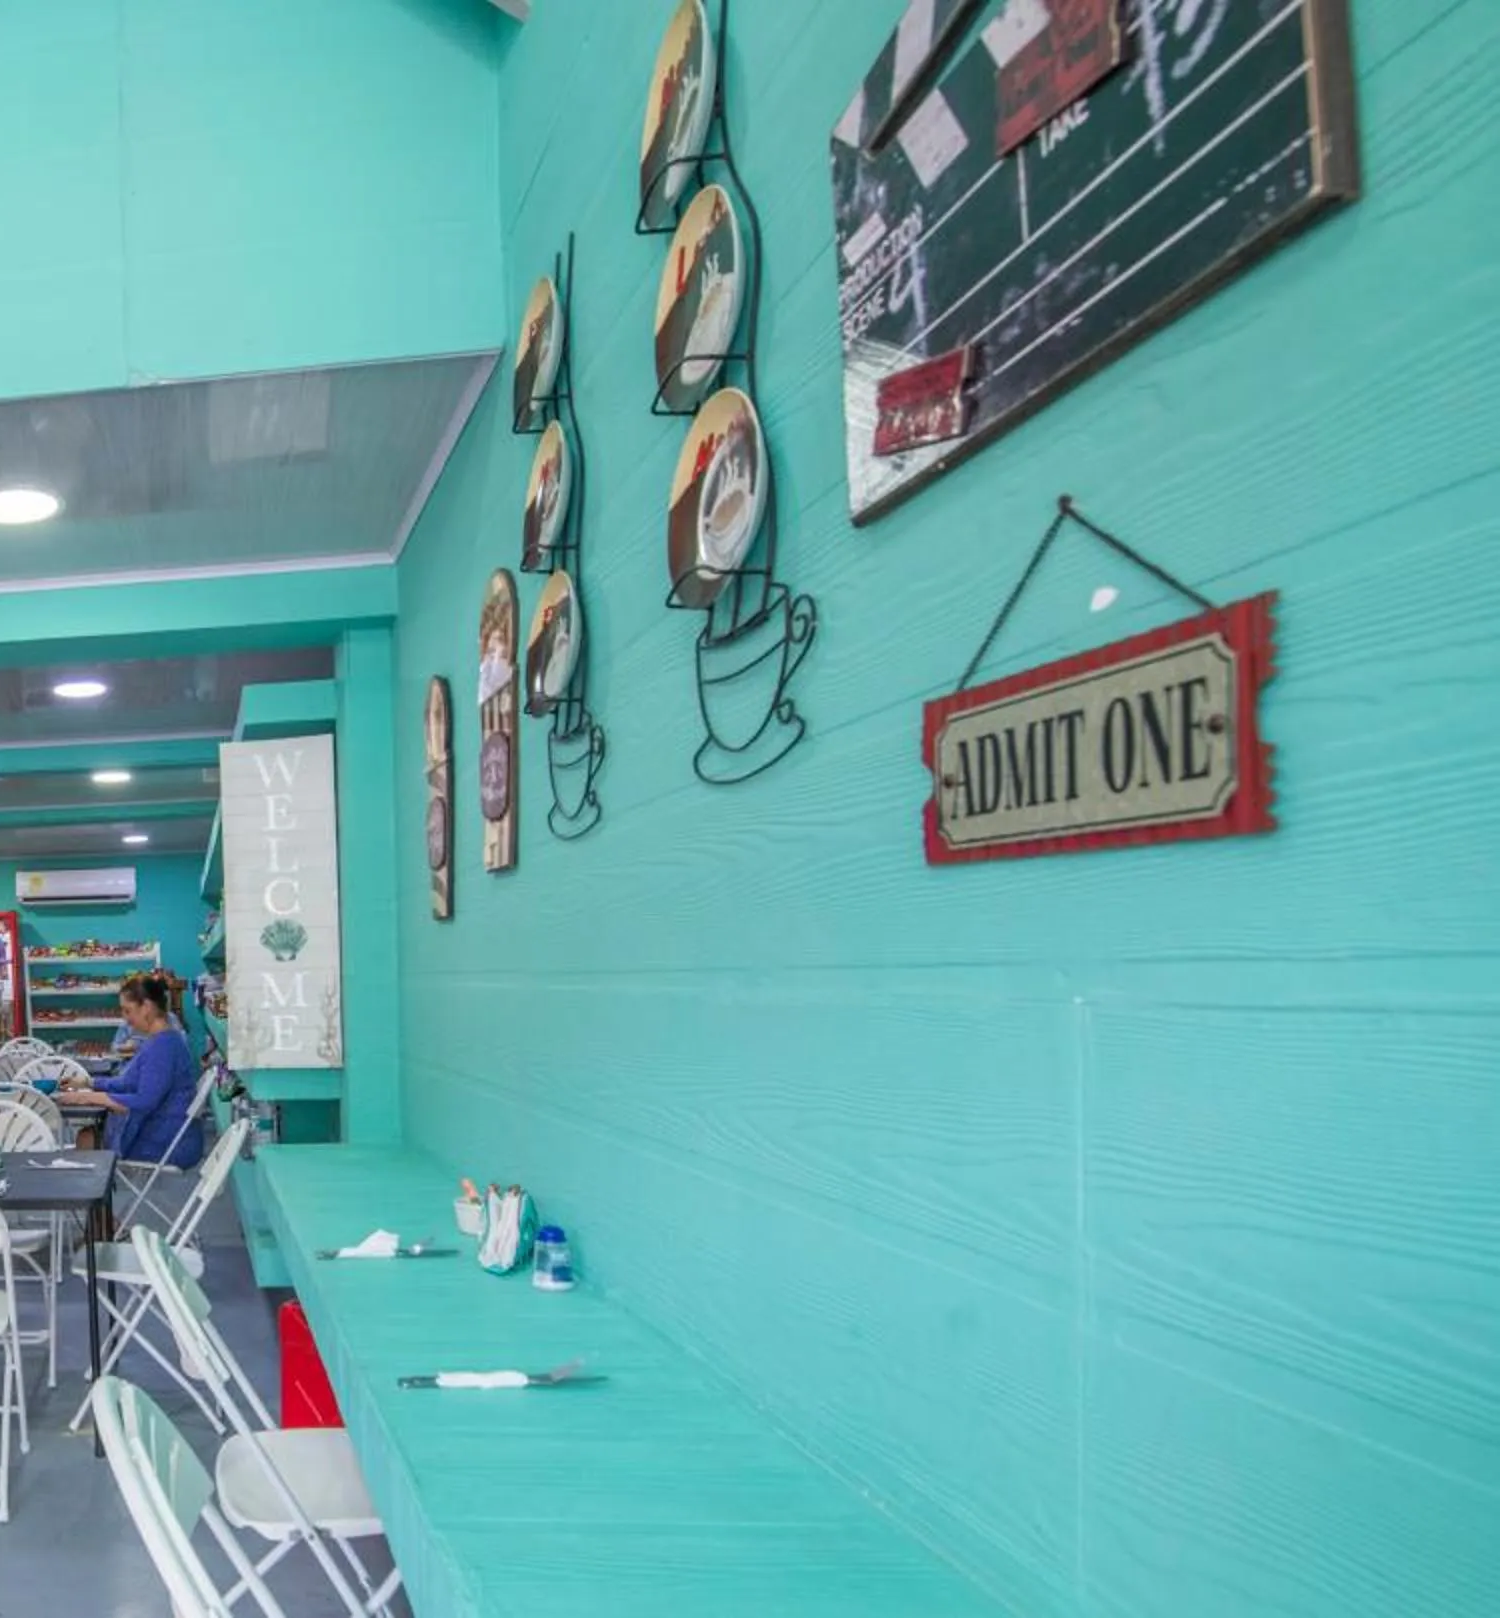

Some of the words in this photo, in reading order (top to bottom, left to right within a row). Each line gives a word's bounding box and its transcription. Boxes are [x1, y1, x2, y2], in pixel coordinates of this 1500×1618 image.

[951, 708, 1085, 820] ADMIT
[1103, 676, 1211, 794] ONE
[253, 750, 311, 1051] WELCME
